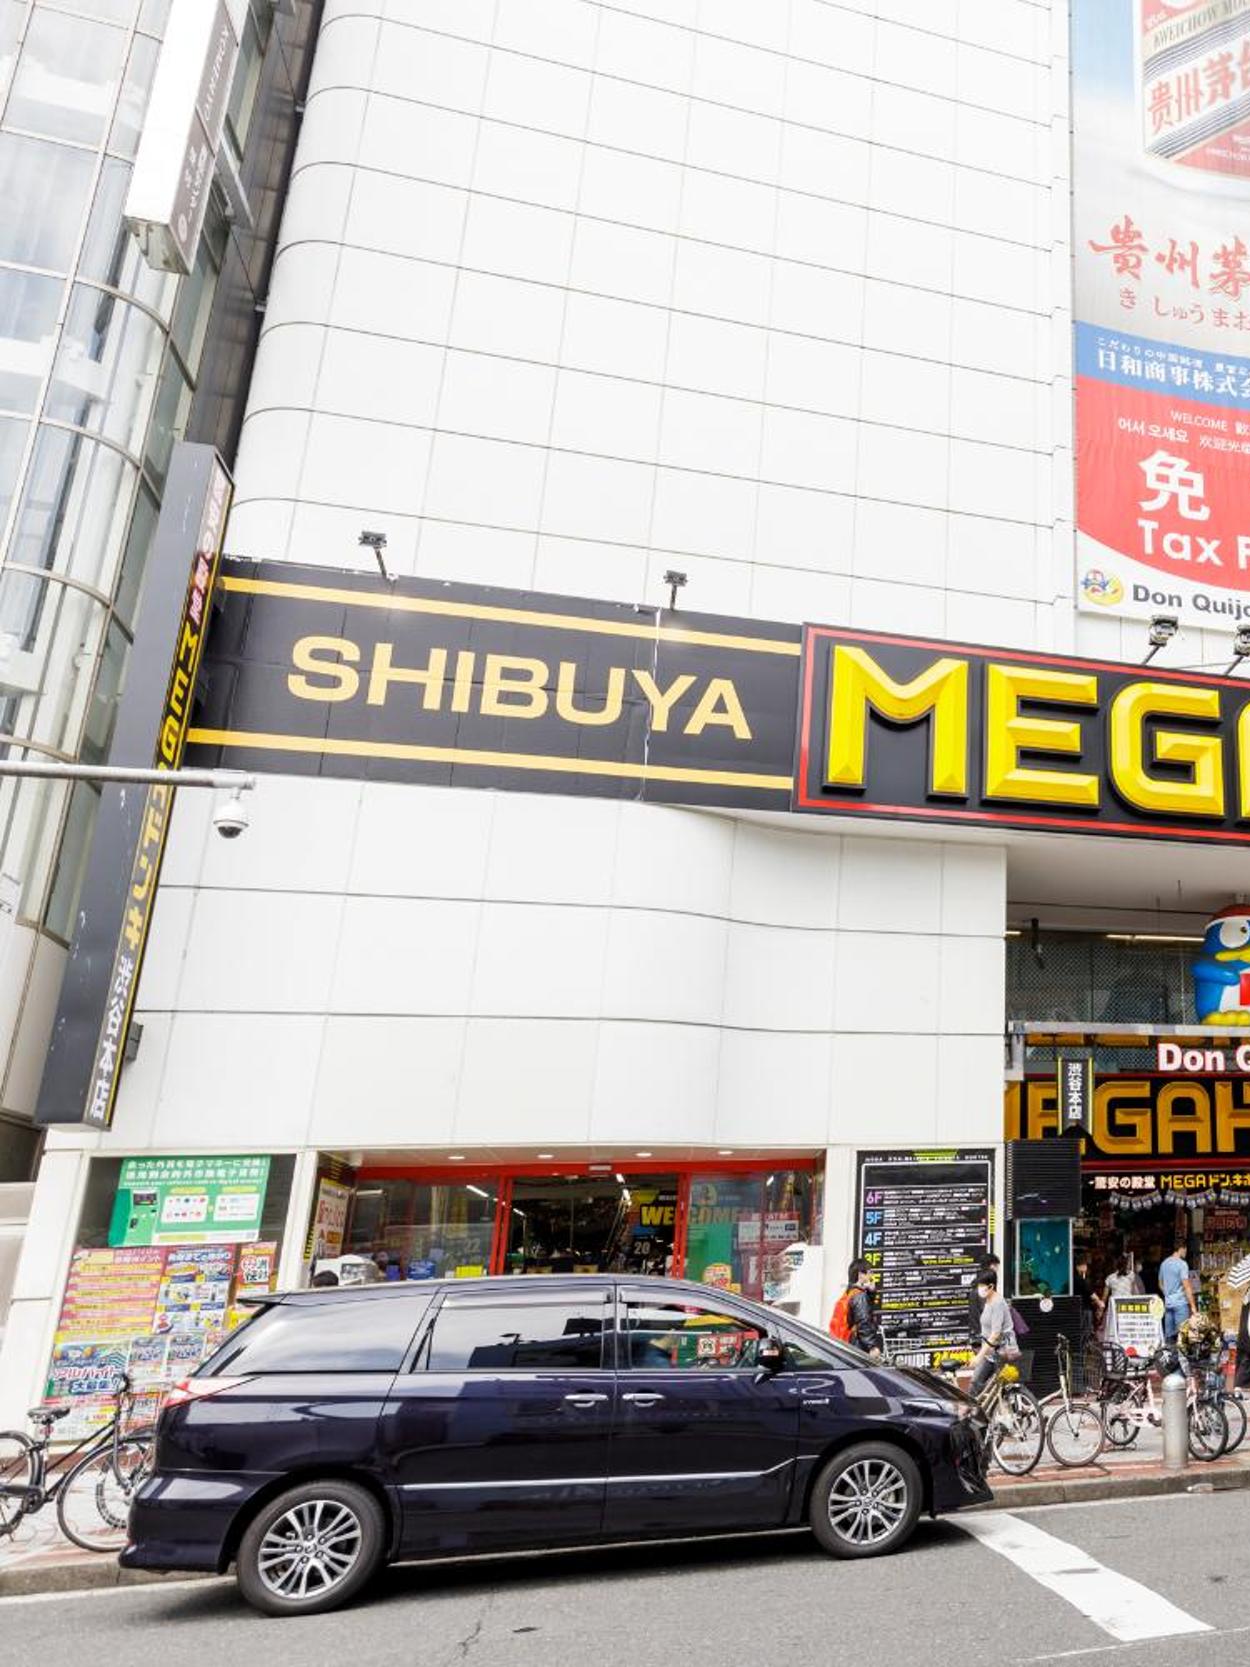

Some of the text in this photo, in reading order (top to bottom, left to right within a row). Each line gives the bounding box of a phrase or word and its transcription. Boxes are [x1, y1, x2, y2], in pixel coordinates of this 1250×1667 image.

[1170, 410, 1228, 432] WELCOME
[1138, 519, 1223, 567] Tax
[1132, 584, 1183, 609] Don
[287, 635, 753, 740] SHIBUYA
[1157, 1043, 1225, 1072] Don
[1067, 1062, 1083, 1119] 渋谷本店
[866, 1190, 882, 1205] 6F
[865, 1210, 882, 1225] 5F
[864, 1231, 882, 1246] 4F
